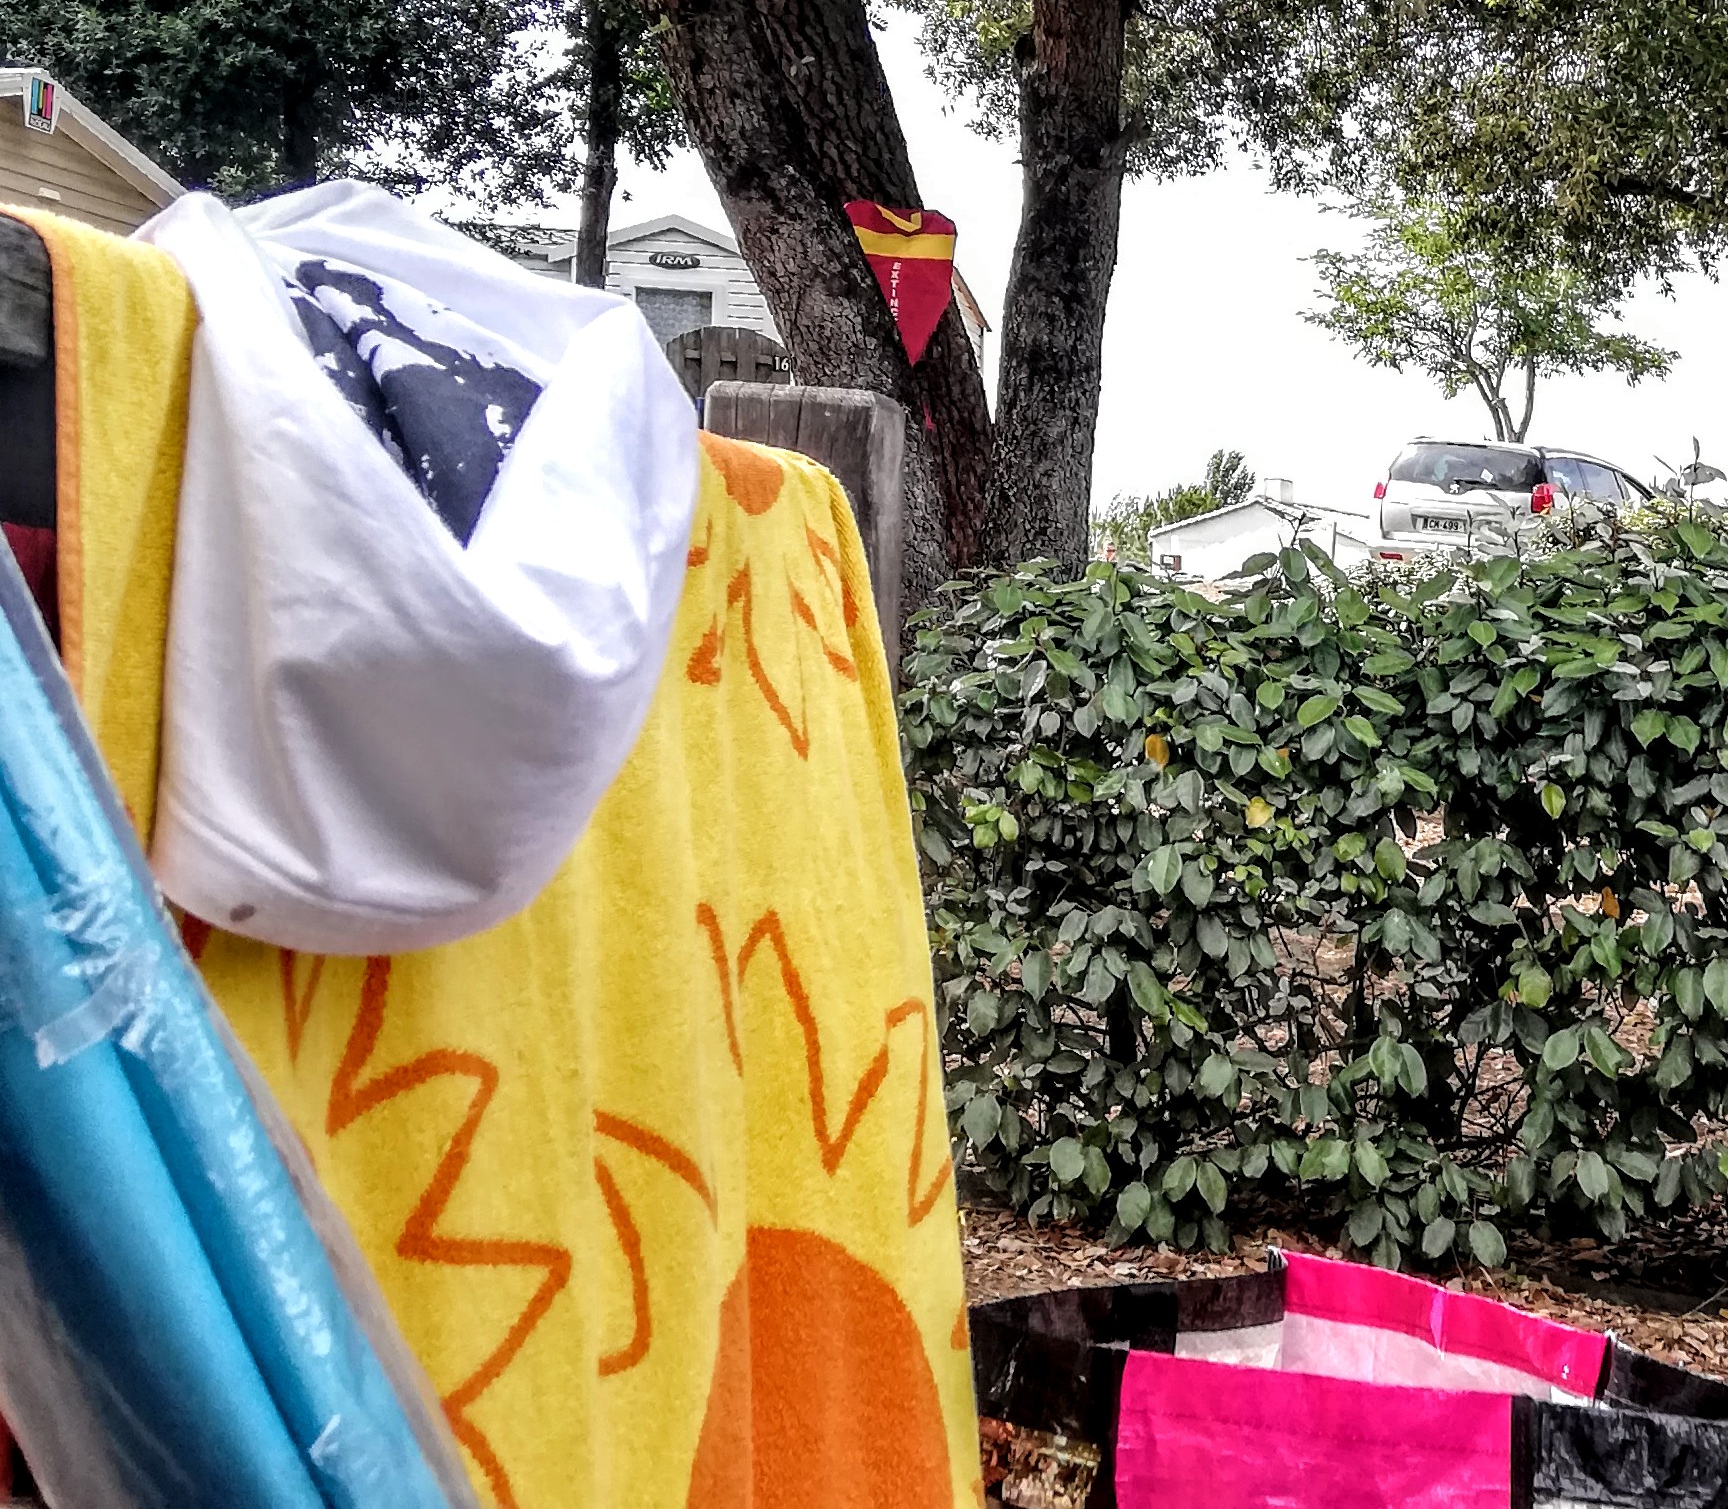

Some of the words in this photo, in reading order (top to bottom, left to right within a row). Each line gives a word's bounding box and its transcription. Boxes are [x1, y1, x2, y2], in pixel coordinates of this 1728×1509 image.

[656, 253, 692, 266] IRM
[889, 262, 902, 321] EXTINC
[774, 356, 789, 371] 16
